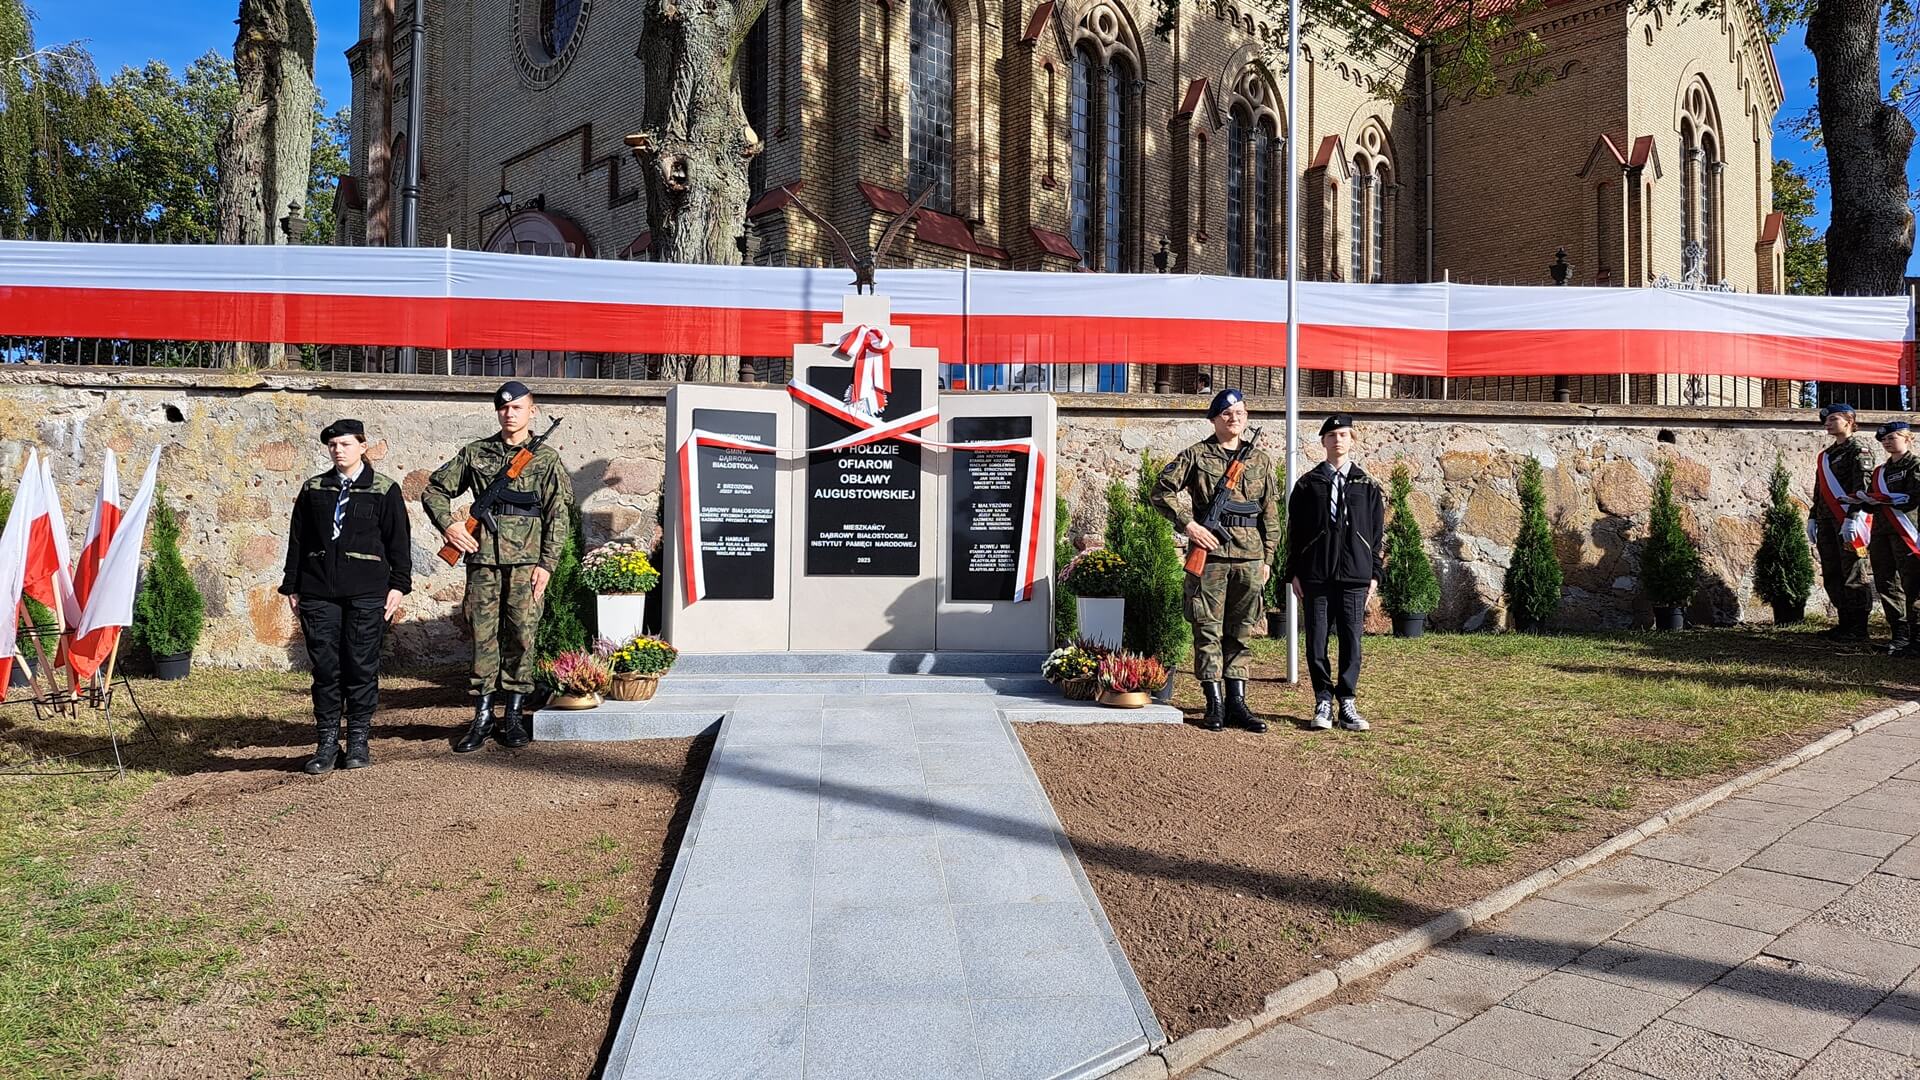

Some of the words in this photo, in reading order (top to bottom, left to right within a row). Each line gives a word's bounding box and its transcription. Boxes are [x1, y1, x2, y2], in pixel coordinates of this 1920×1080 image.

[850, 444, 900, 454] HOŁDZIE
[712, 462, 759, 470] BIAŁOSTOCKA
[838, 458, 893, 470] OFIAROM
[840, 474, 891, 484] OBŁAWY
[814, 488, 916, 500] AUGUSTOWSKIEJ
